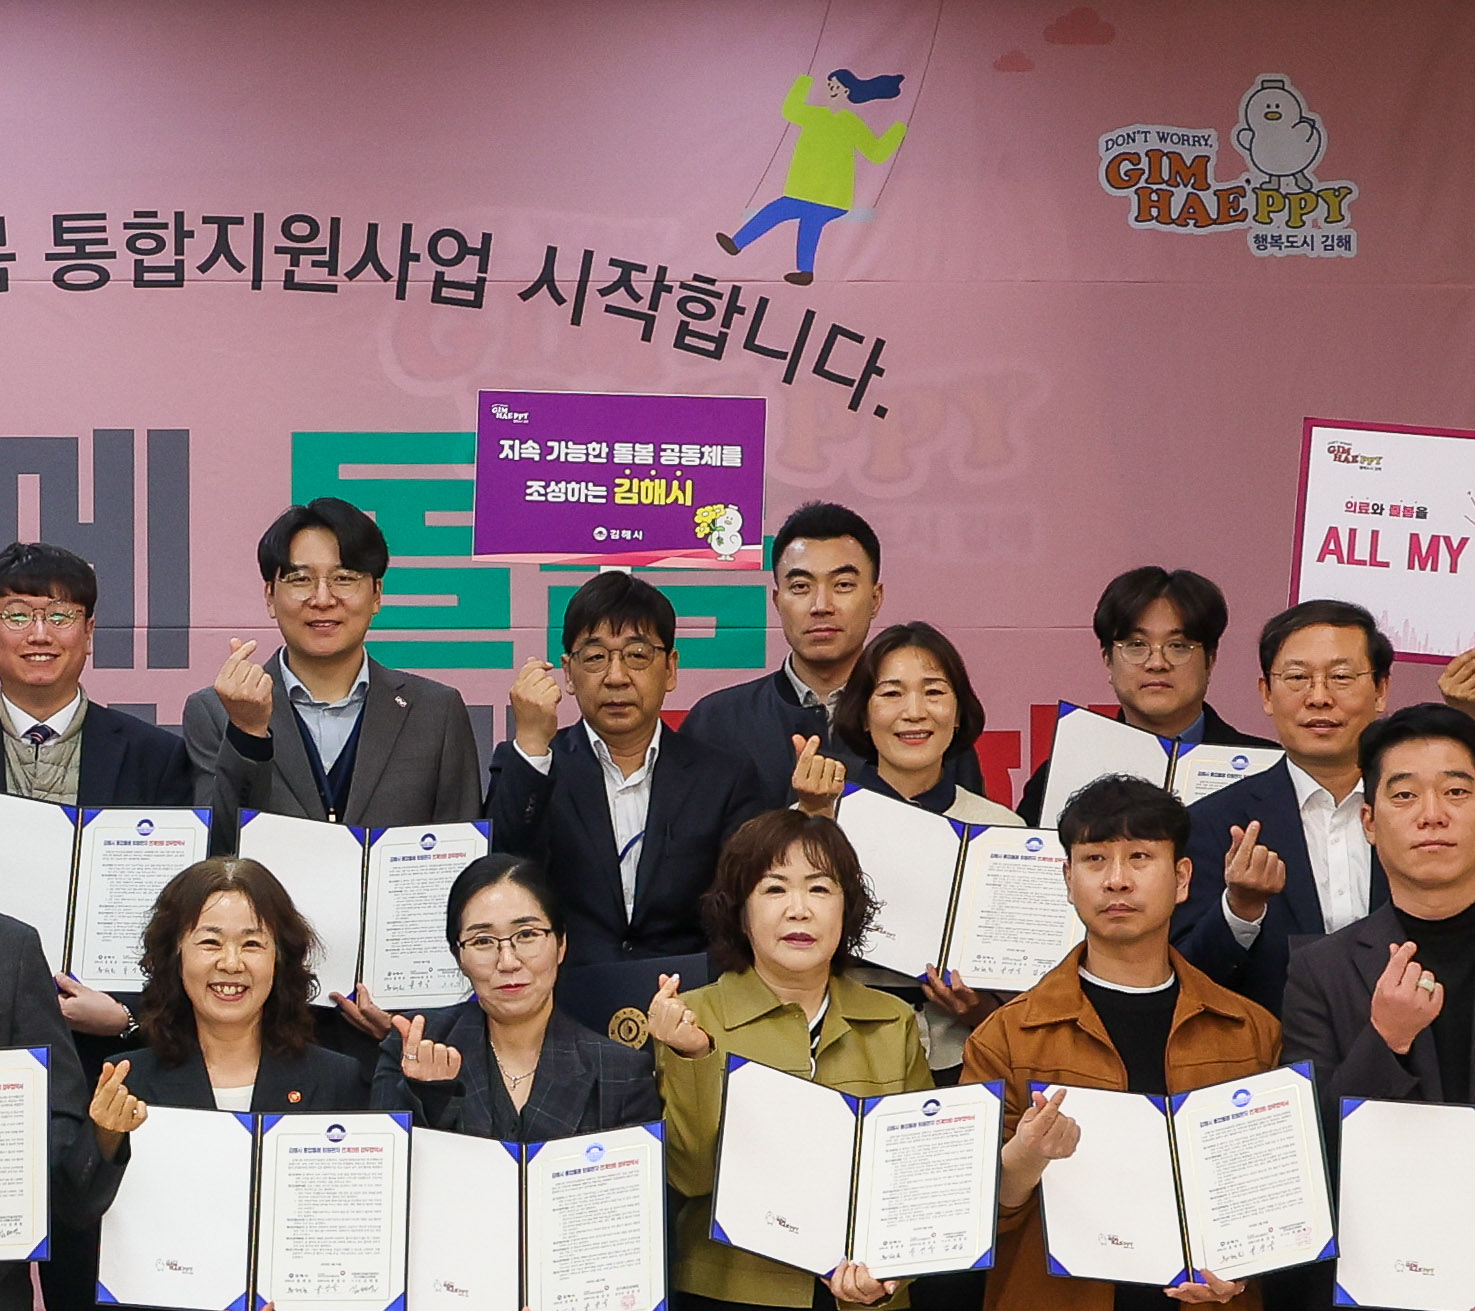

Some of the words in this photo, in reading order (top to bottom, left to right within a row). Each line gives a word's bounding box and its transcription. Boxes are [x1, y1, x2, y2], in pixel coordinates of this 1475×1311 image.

[1104, 129, 1151, 152] DON'T
[1105, 148, 1212, 191] GIM
[1253, 234, 1316, 251] 행복도시
[1321, 234, 1352, 251] 김해
[44, 210, 493, 308] 통합지원사업
[517, 244, 891, 420] 시작합니다.
[498, 439, 541, 462] 지속
[546, 441, 609, 464] 가능한
[612, 443, 655, 465] 돌봄
[659, 444, 743, 468] 공동체를
[525, 481, 608, 504] 조성하는
[614, 477, 694, 506] 김해시
[1344, 501, 1385, 516] 의료와
[609, 528, 643, 540] 김해시
[1316, 526, 1390, 569] ALL
[1406, 532, 1470, 575] MY
